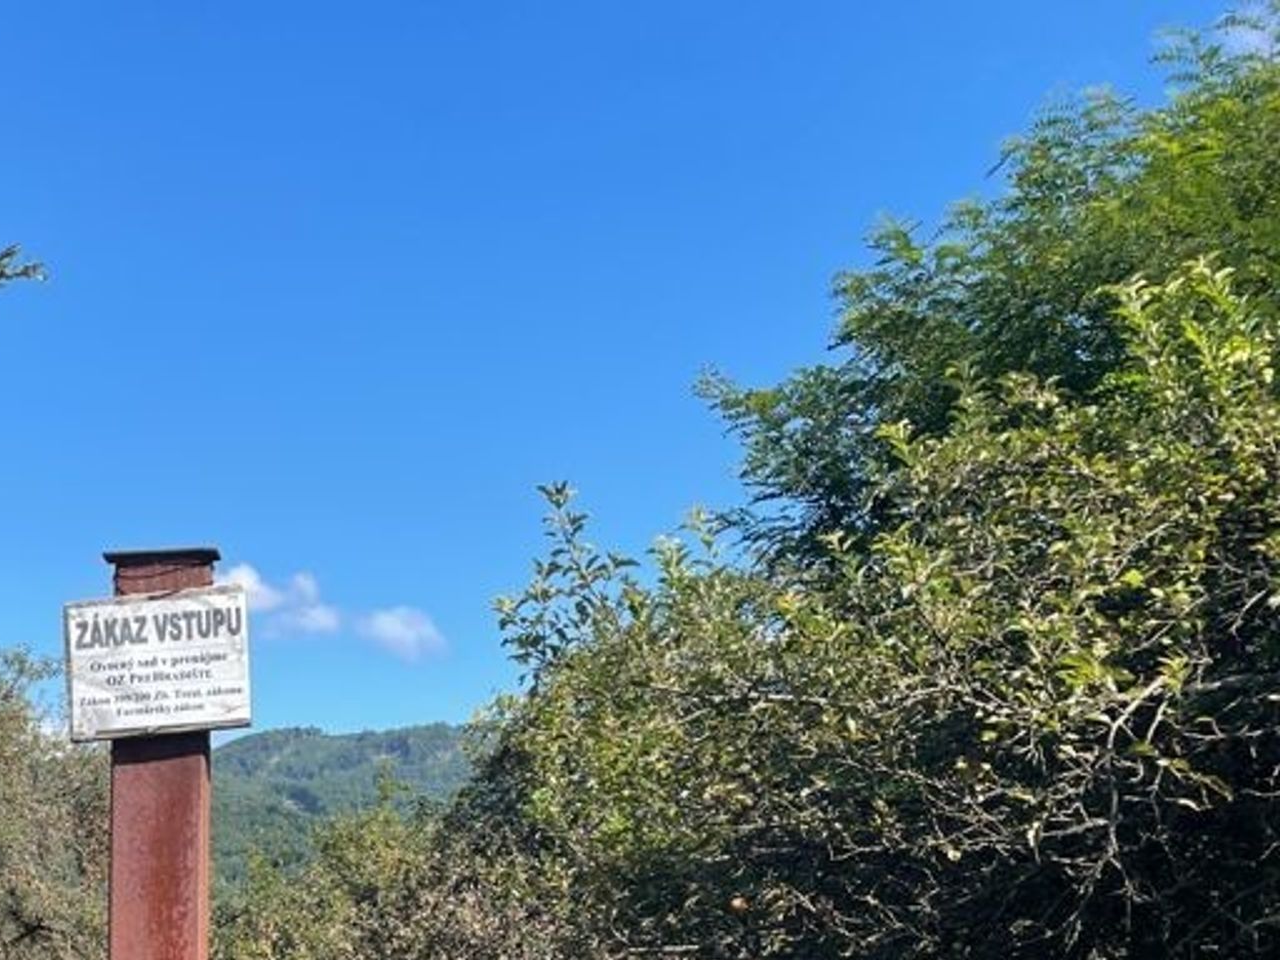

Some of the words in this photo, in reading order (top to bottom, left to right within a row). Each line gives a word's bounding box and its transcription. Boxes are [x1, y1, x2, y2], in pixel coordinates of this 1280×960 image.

[75, 613, 148, 650] ZÁKAZ
[153, 607, 241, 642] VSTUPU
[137, 655, 158, 668] sad
